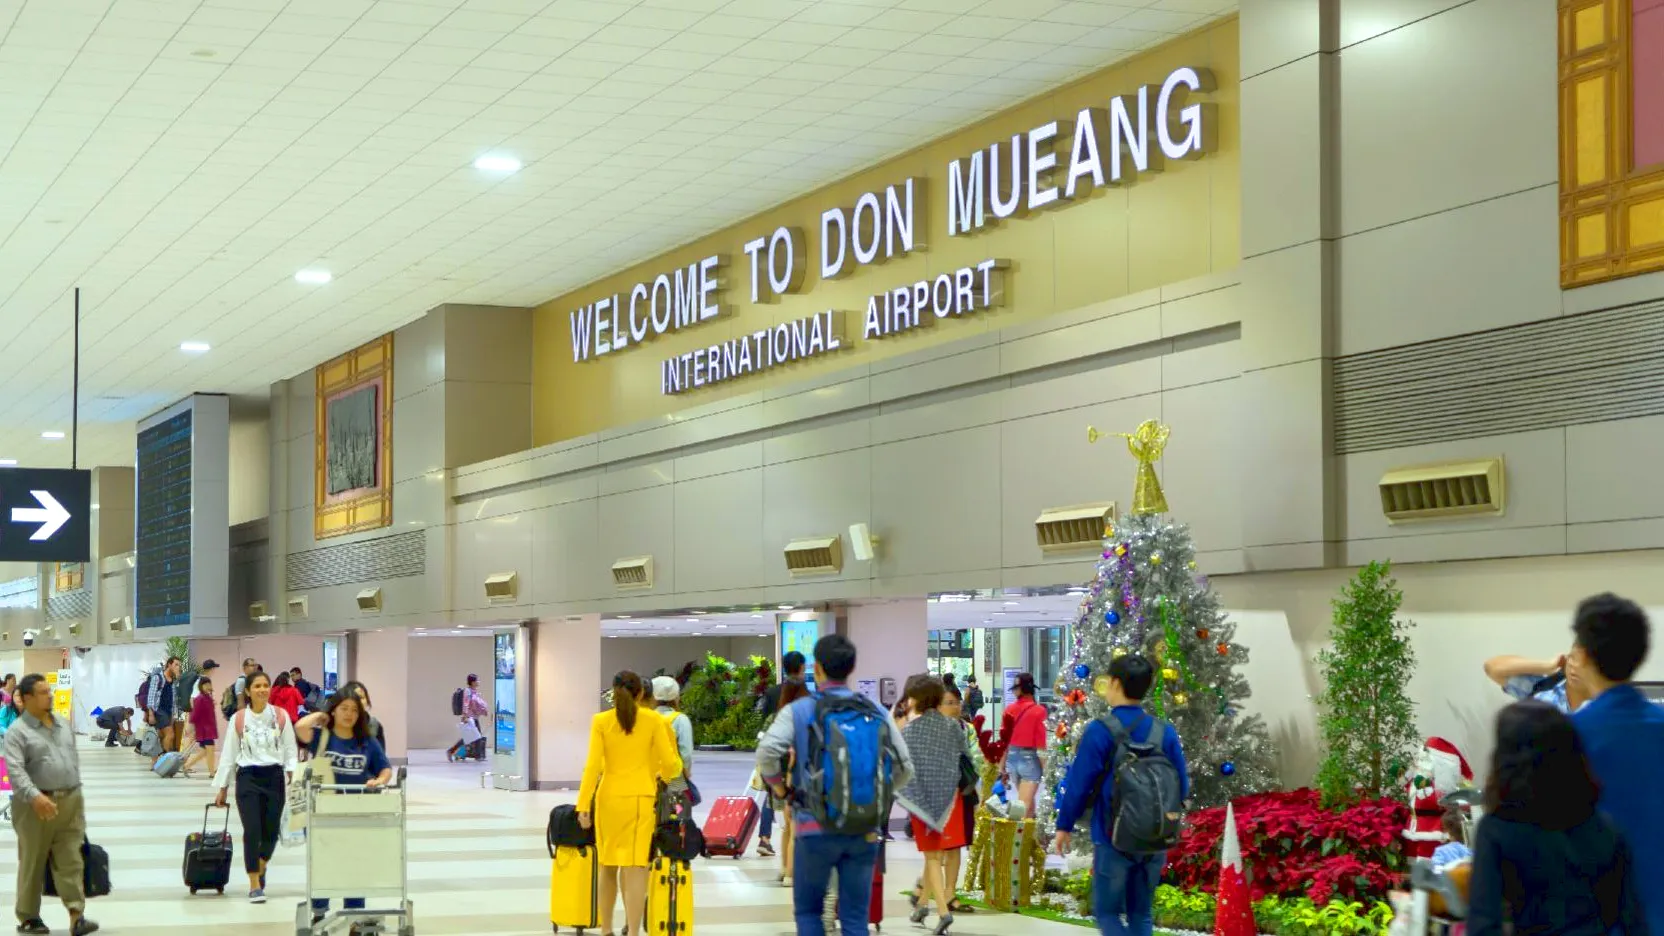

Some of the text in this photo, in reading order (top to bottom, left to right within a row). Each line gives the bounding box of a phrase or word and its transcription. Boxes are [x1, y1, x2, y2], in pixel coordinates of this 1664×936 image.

[570, 67, 1204, 362] WELCOME TO DON MUEANG
[660, 258, 996, 395] INTERNATIONAL AIRPORT
